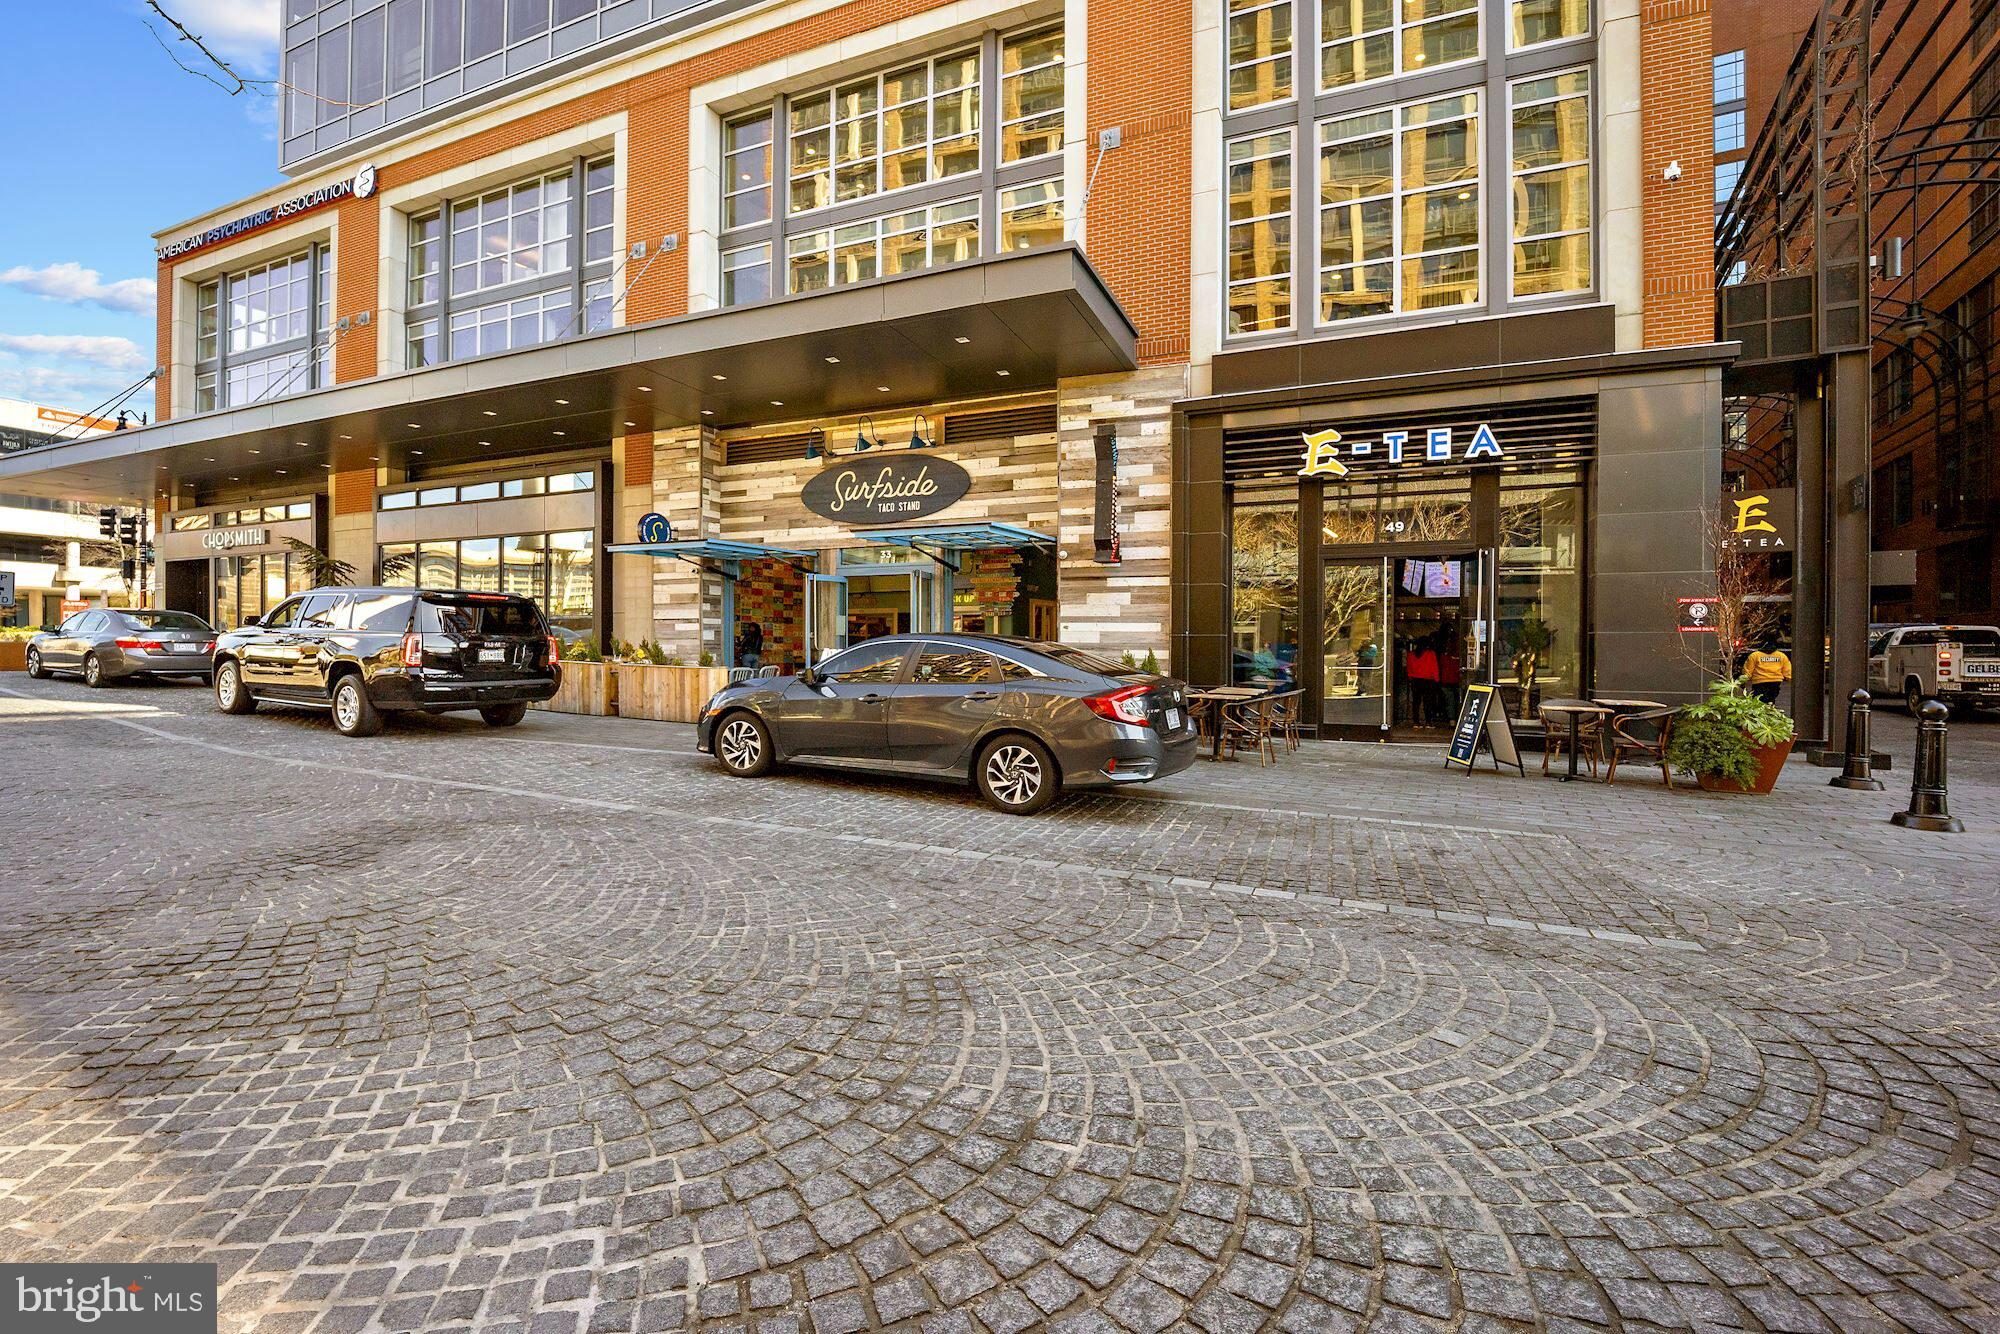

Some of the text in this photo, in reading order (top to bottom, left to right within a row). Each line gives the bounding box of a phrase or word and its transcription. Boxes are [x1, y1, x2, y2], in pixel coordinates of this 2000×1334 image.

[157, 180, 352, 260] AMERICAN PSYCHIATRIC ASSOCIATION
[1297, 424, 1504, 477] E-TEA
[831, 465, 939, 511] Surfside
[878, 501, 920, 513] TACO STAND
[1730, 495, 1777, 533] E
[1385, 522, 1405, 533] 49
[202, 528, 262, 550] CHOPSMITH
[880, 551, 892, 559] 33
[964, 594, 975, 603] UP
